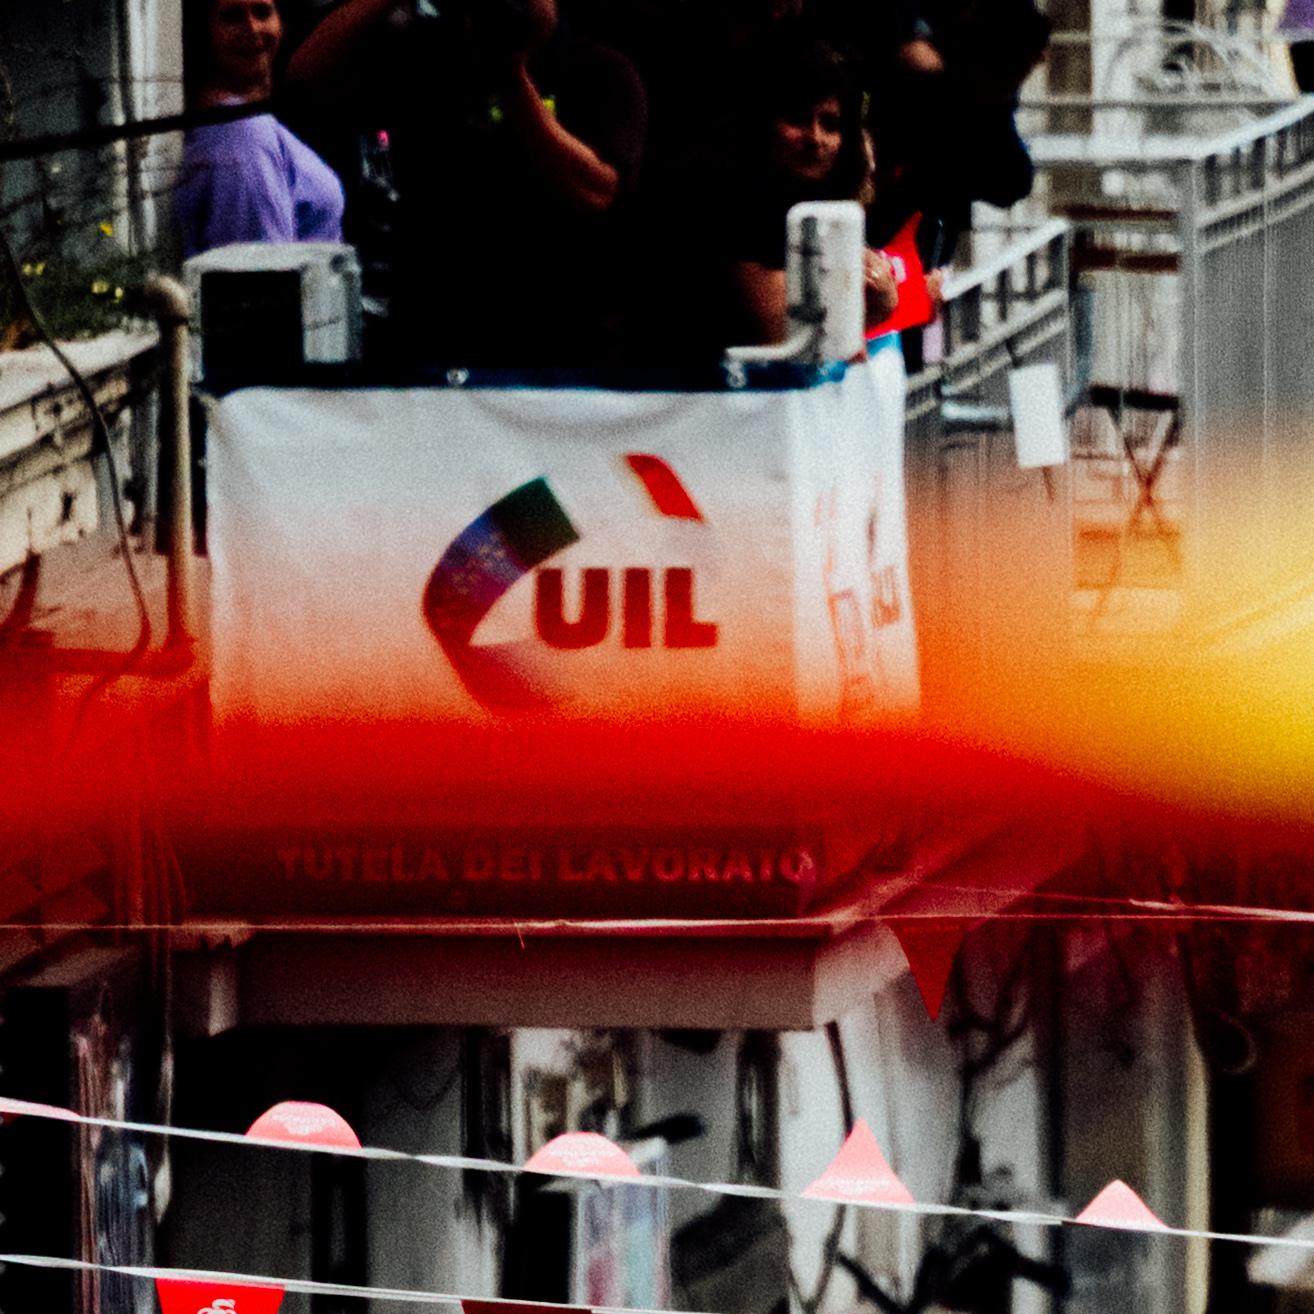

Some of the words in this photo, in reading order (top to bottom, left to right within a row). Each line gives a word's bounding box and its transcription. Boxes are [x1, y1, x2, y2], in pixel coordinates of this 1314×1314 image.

[535, 566, 719, 649] UIL
[277, 847, 448, 882] TUTELA
[463, 848, 542, 882] DEI
